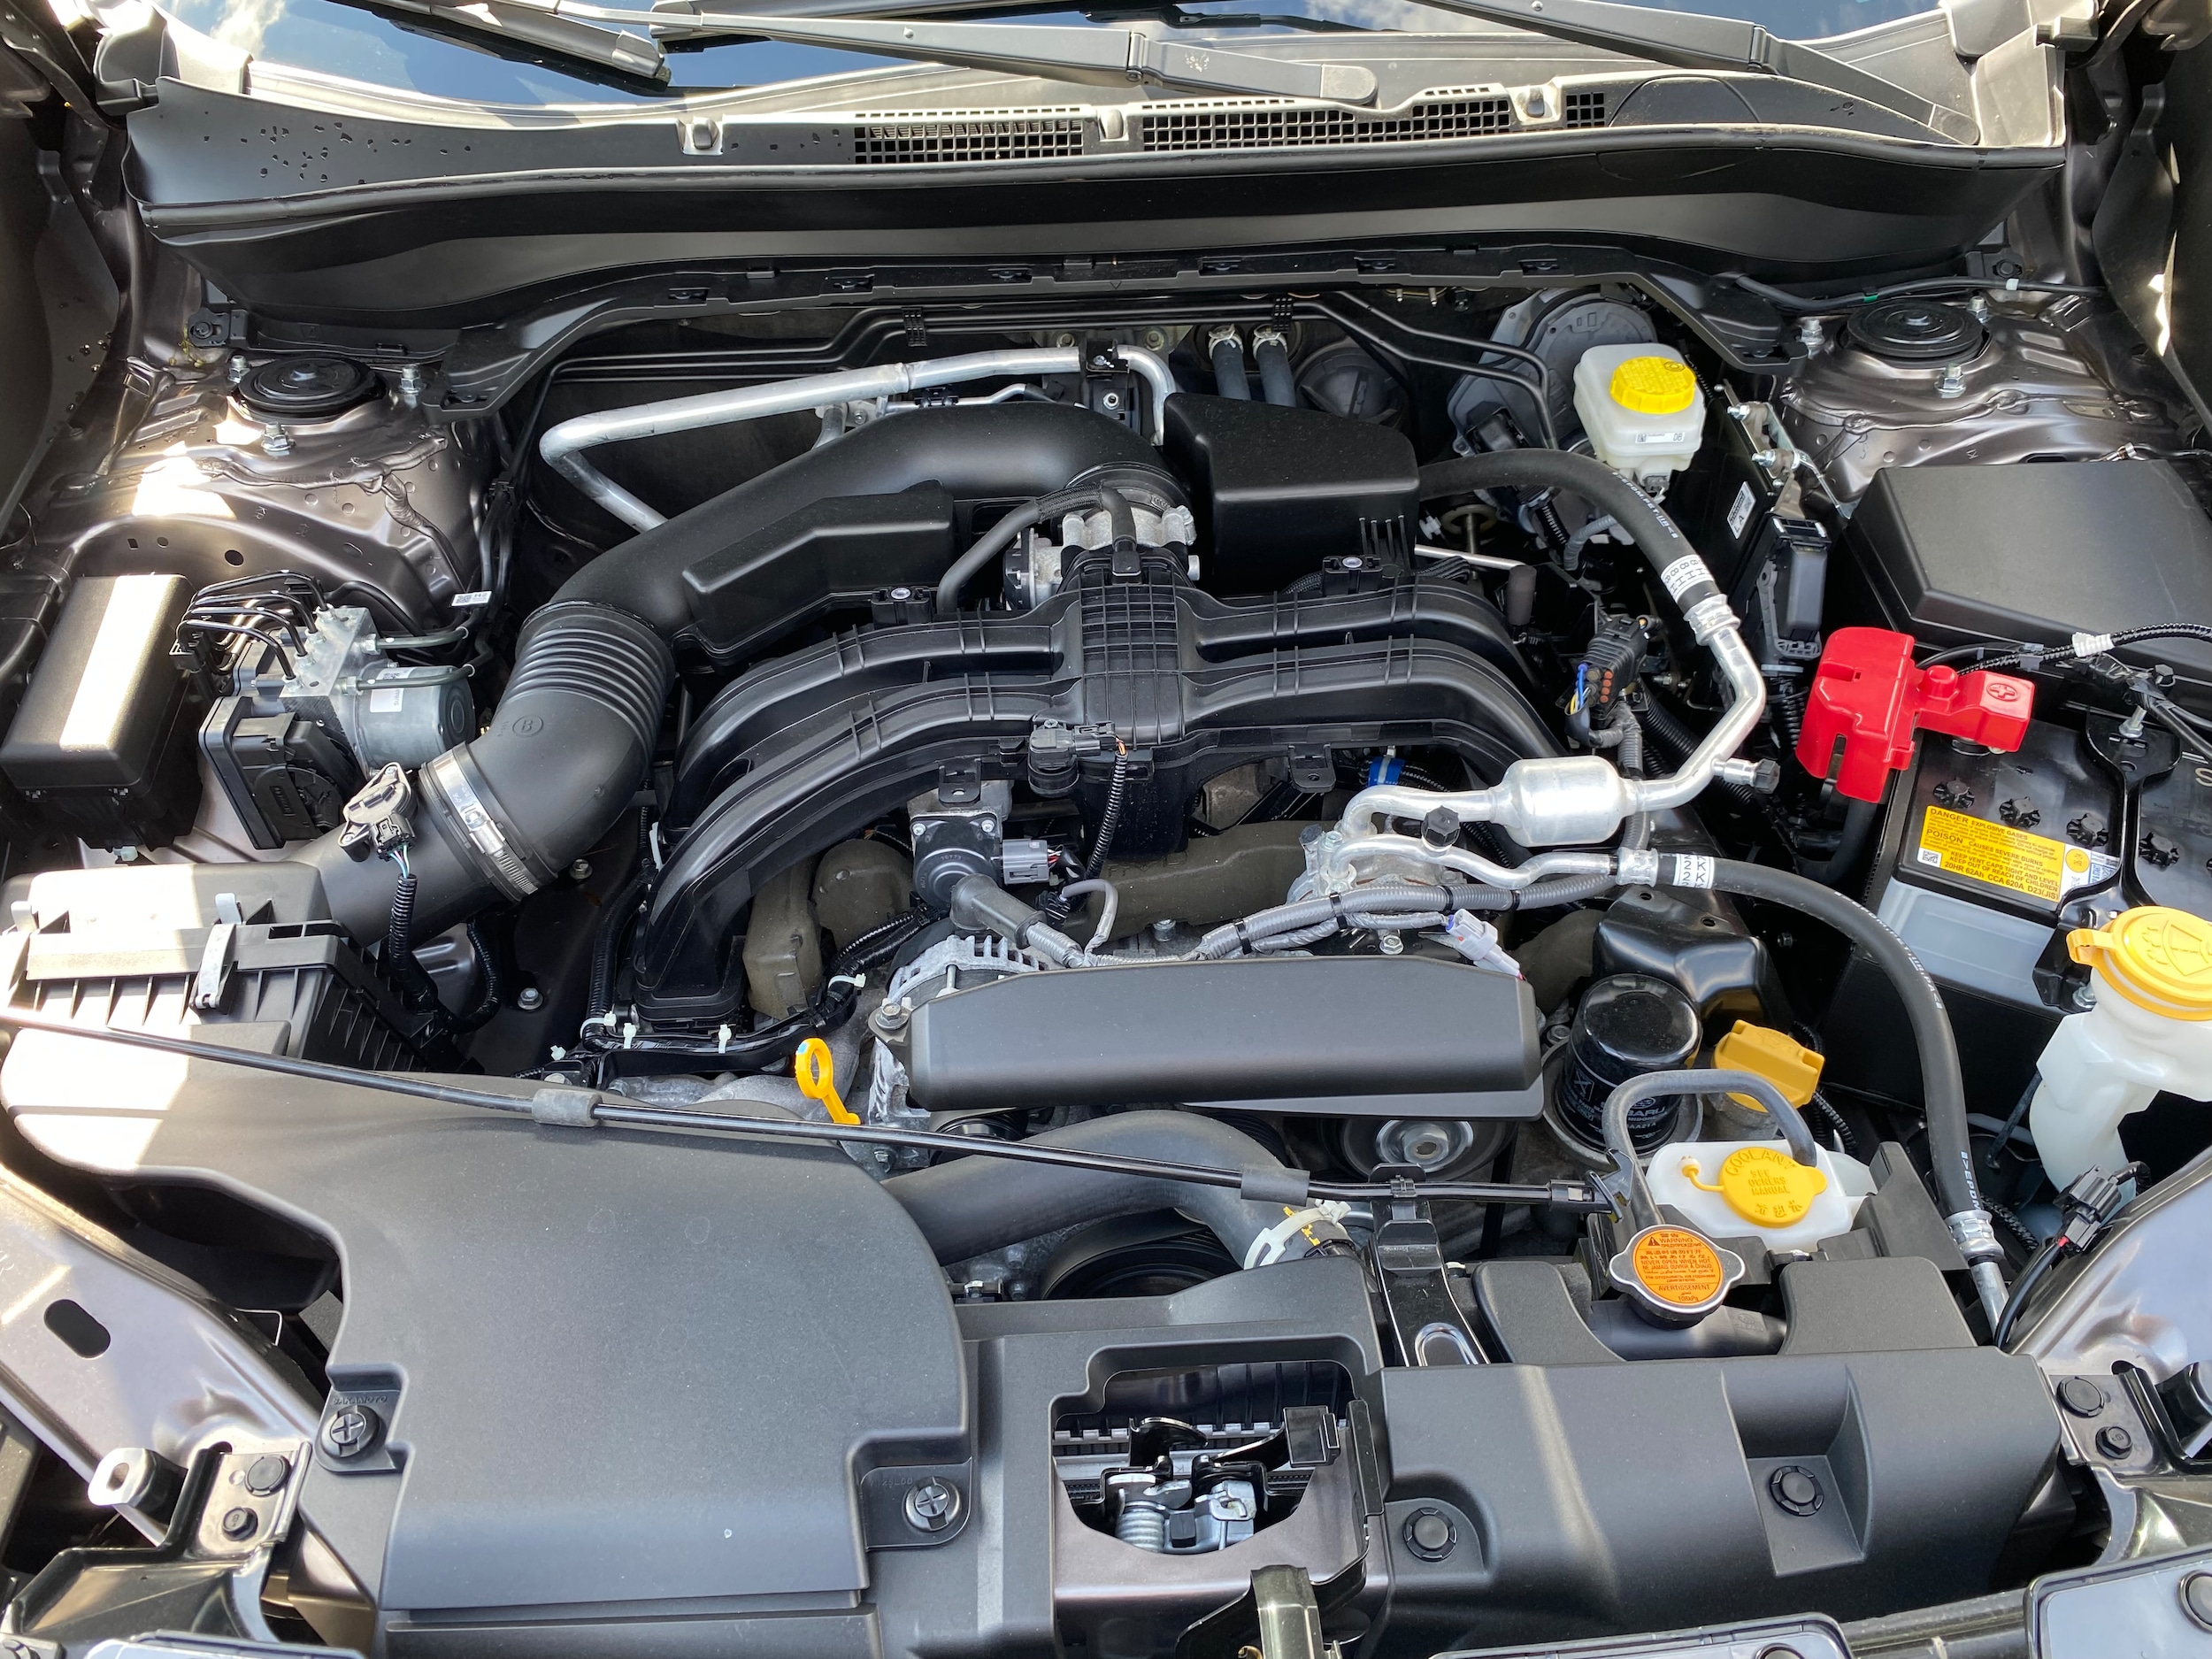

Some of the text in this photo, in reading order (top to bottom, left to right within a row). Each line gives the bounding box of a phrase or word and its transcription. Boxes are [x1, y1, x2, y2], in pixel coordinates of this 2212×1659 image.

[1930, 808, 1968, 824] DANGER
[1971, 820, 2005, 833] EXPLOSIVE
[2006, 830, 2027, 840] GASES
[1926, 828, 1962, 843] POISON
[1968, 841, 1993, 852] CAUSES
[1994, 849, 2019, 860] SEVERE
[2021, 856, 2042, 866] BURNS
[1944, 861, 2058, 901] 20HR 62Ah CCA 620A D23(JIS)
[1949, 856, 1966, 864] KEEP
[1992, 868, 2015, 879] REACH
[2025, 878, 2057, 892] CHILDREN
[1950, 850, 1967, 859] KEEP
[1968, 856, 1985, 864] VENT
[1985, 860, 2003, 870] CAPS
[2005, 866, 2023, 876] TIGHT
[2024, 872, 2038, 880] AND
[2039, 876, 2059, 887] LEVEL
[1627, 1106, 1665, 1116] BARU
[1725, 1149, 1796, 1175] COOLANT
[1751, 1185, 1791, 1196] MANUAL
